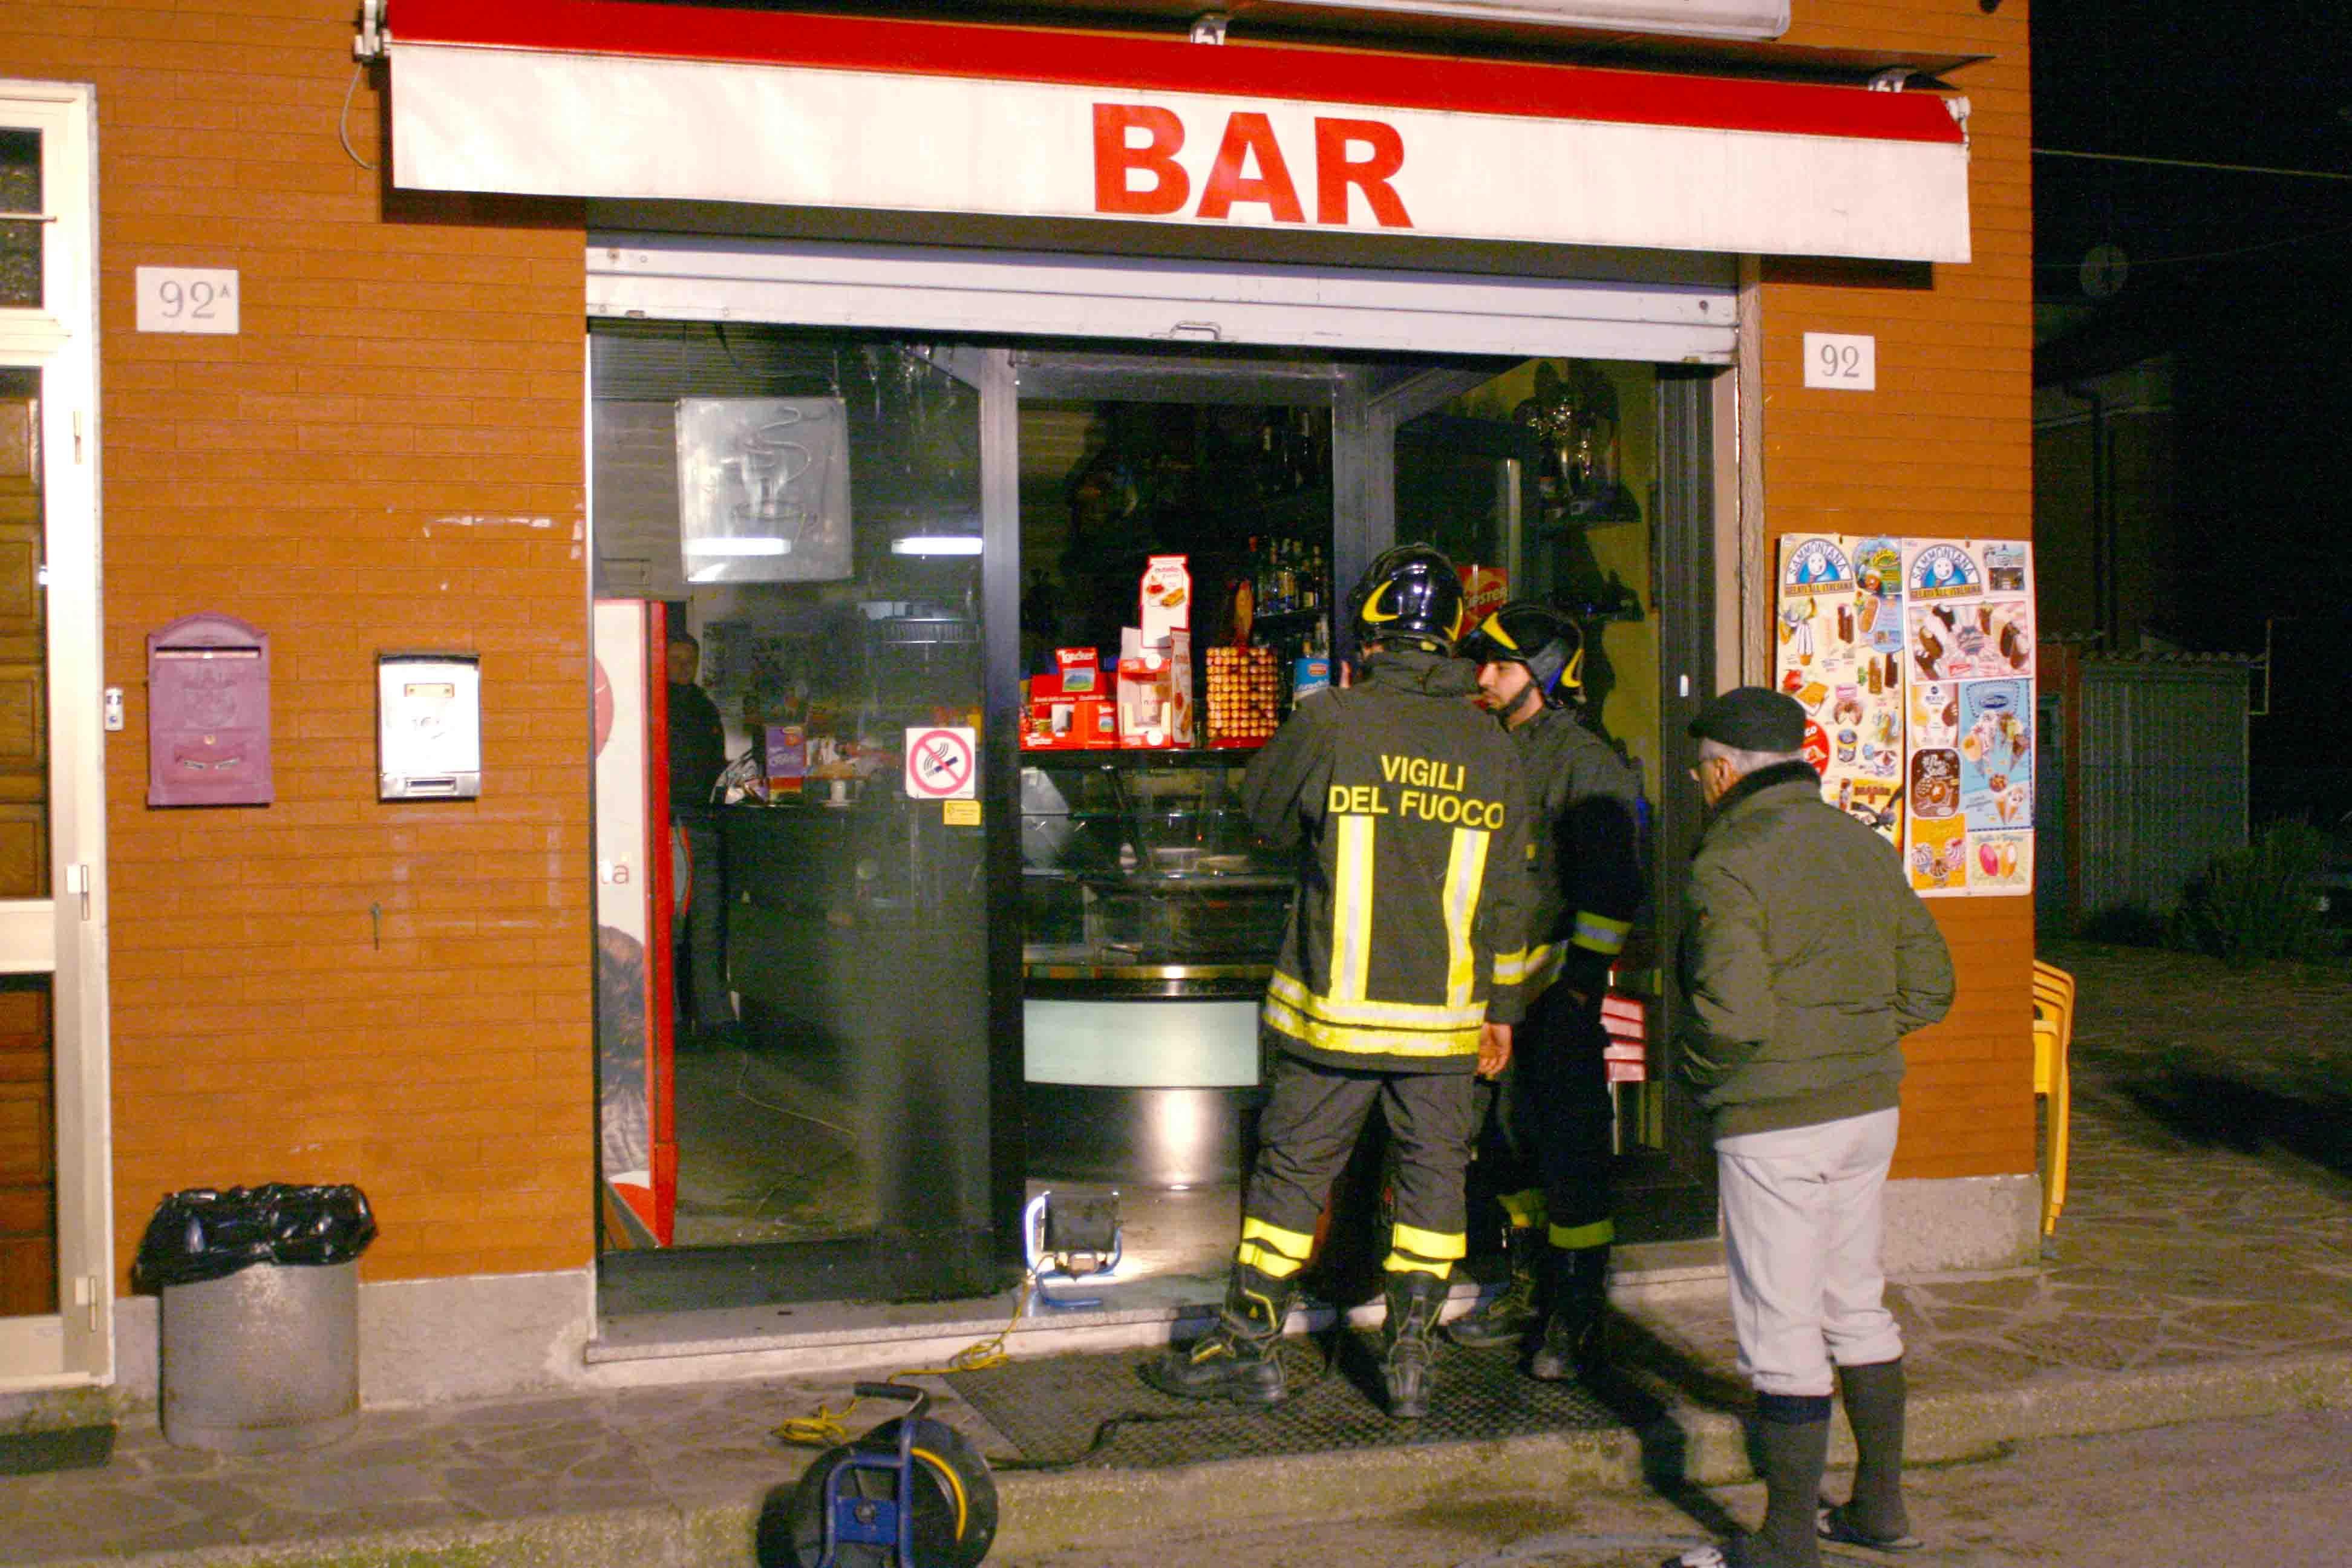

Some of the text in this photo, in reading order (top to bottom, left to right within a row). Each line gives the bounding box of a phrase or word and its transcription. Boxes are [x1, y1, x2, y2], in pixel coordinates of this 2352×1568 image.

[1092, 102, 1414, 228] BAR
[1821, 344, 1860, 378] 92
[1788, 540, 1846, 575] SAMMONTANA
[1910, 545, 1976, 580] SAMMONTANA
[1380, 754, 1466, 792] VIGILI
[1328, 785, 1505, 830] DEL FUOCO
